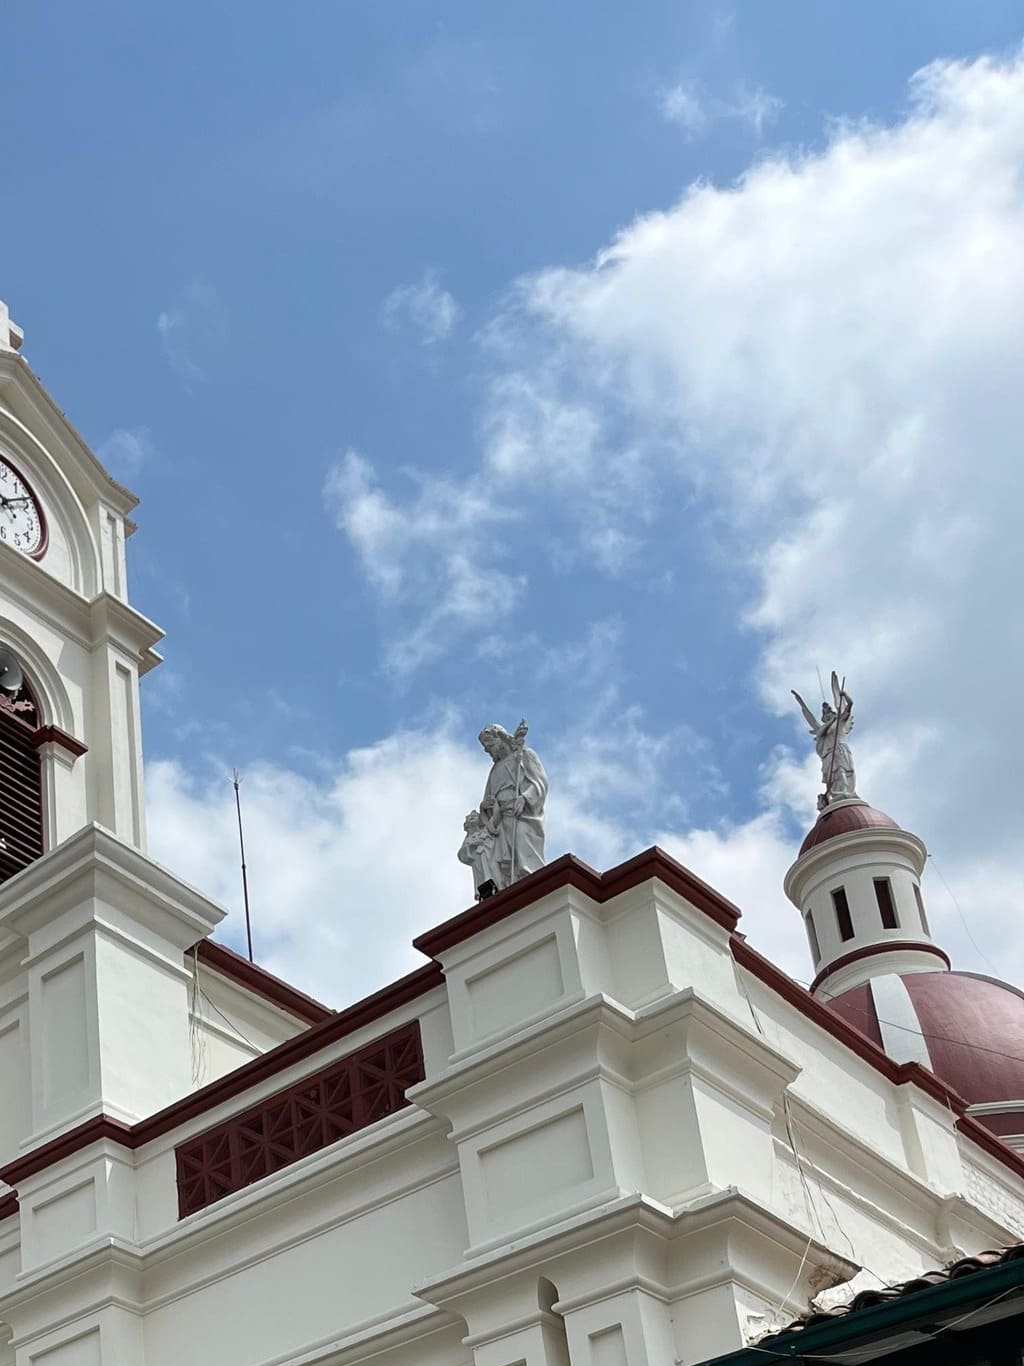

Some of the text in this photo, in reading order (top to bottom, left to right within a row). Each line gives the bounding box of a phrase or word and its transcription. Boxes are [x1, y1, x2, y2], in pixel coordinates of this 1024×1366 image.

[13, 482, 18, 494] 1
[23, 501, 29, 514] 2
[27, 518, 34, 531] 3
[0, 526, 7, 539] 6
[23, 531, 31, 543] 4
[14, 533, 21, 546] 5
